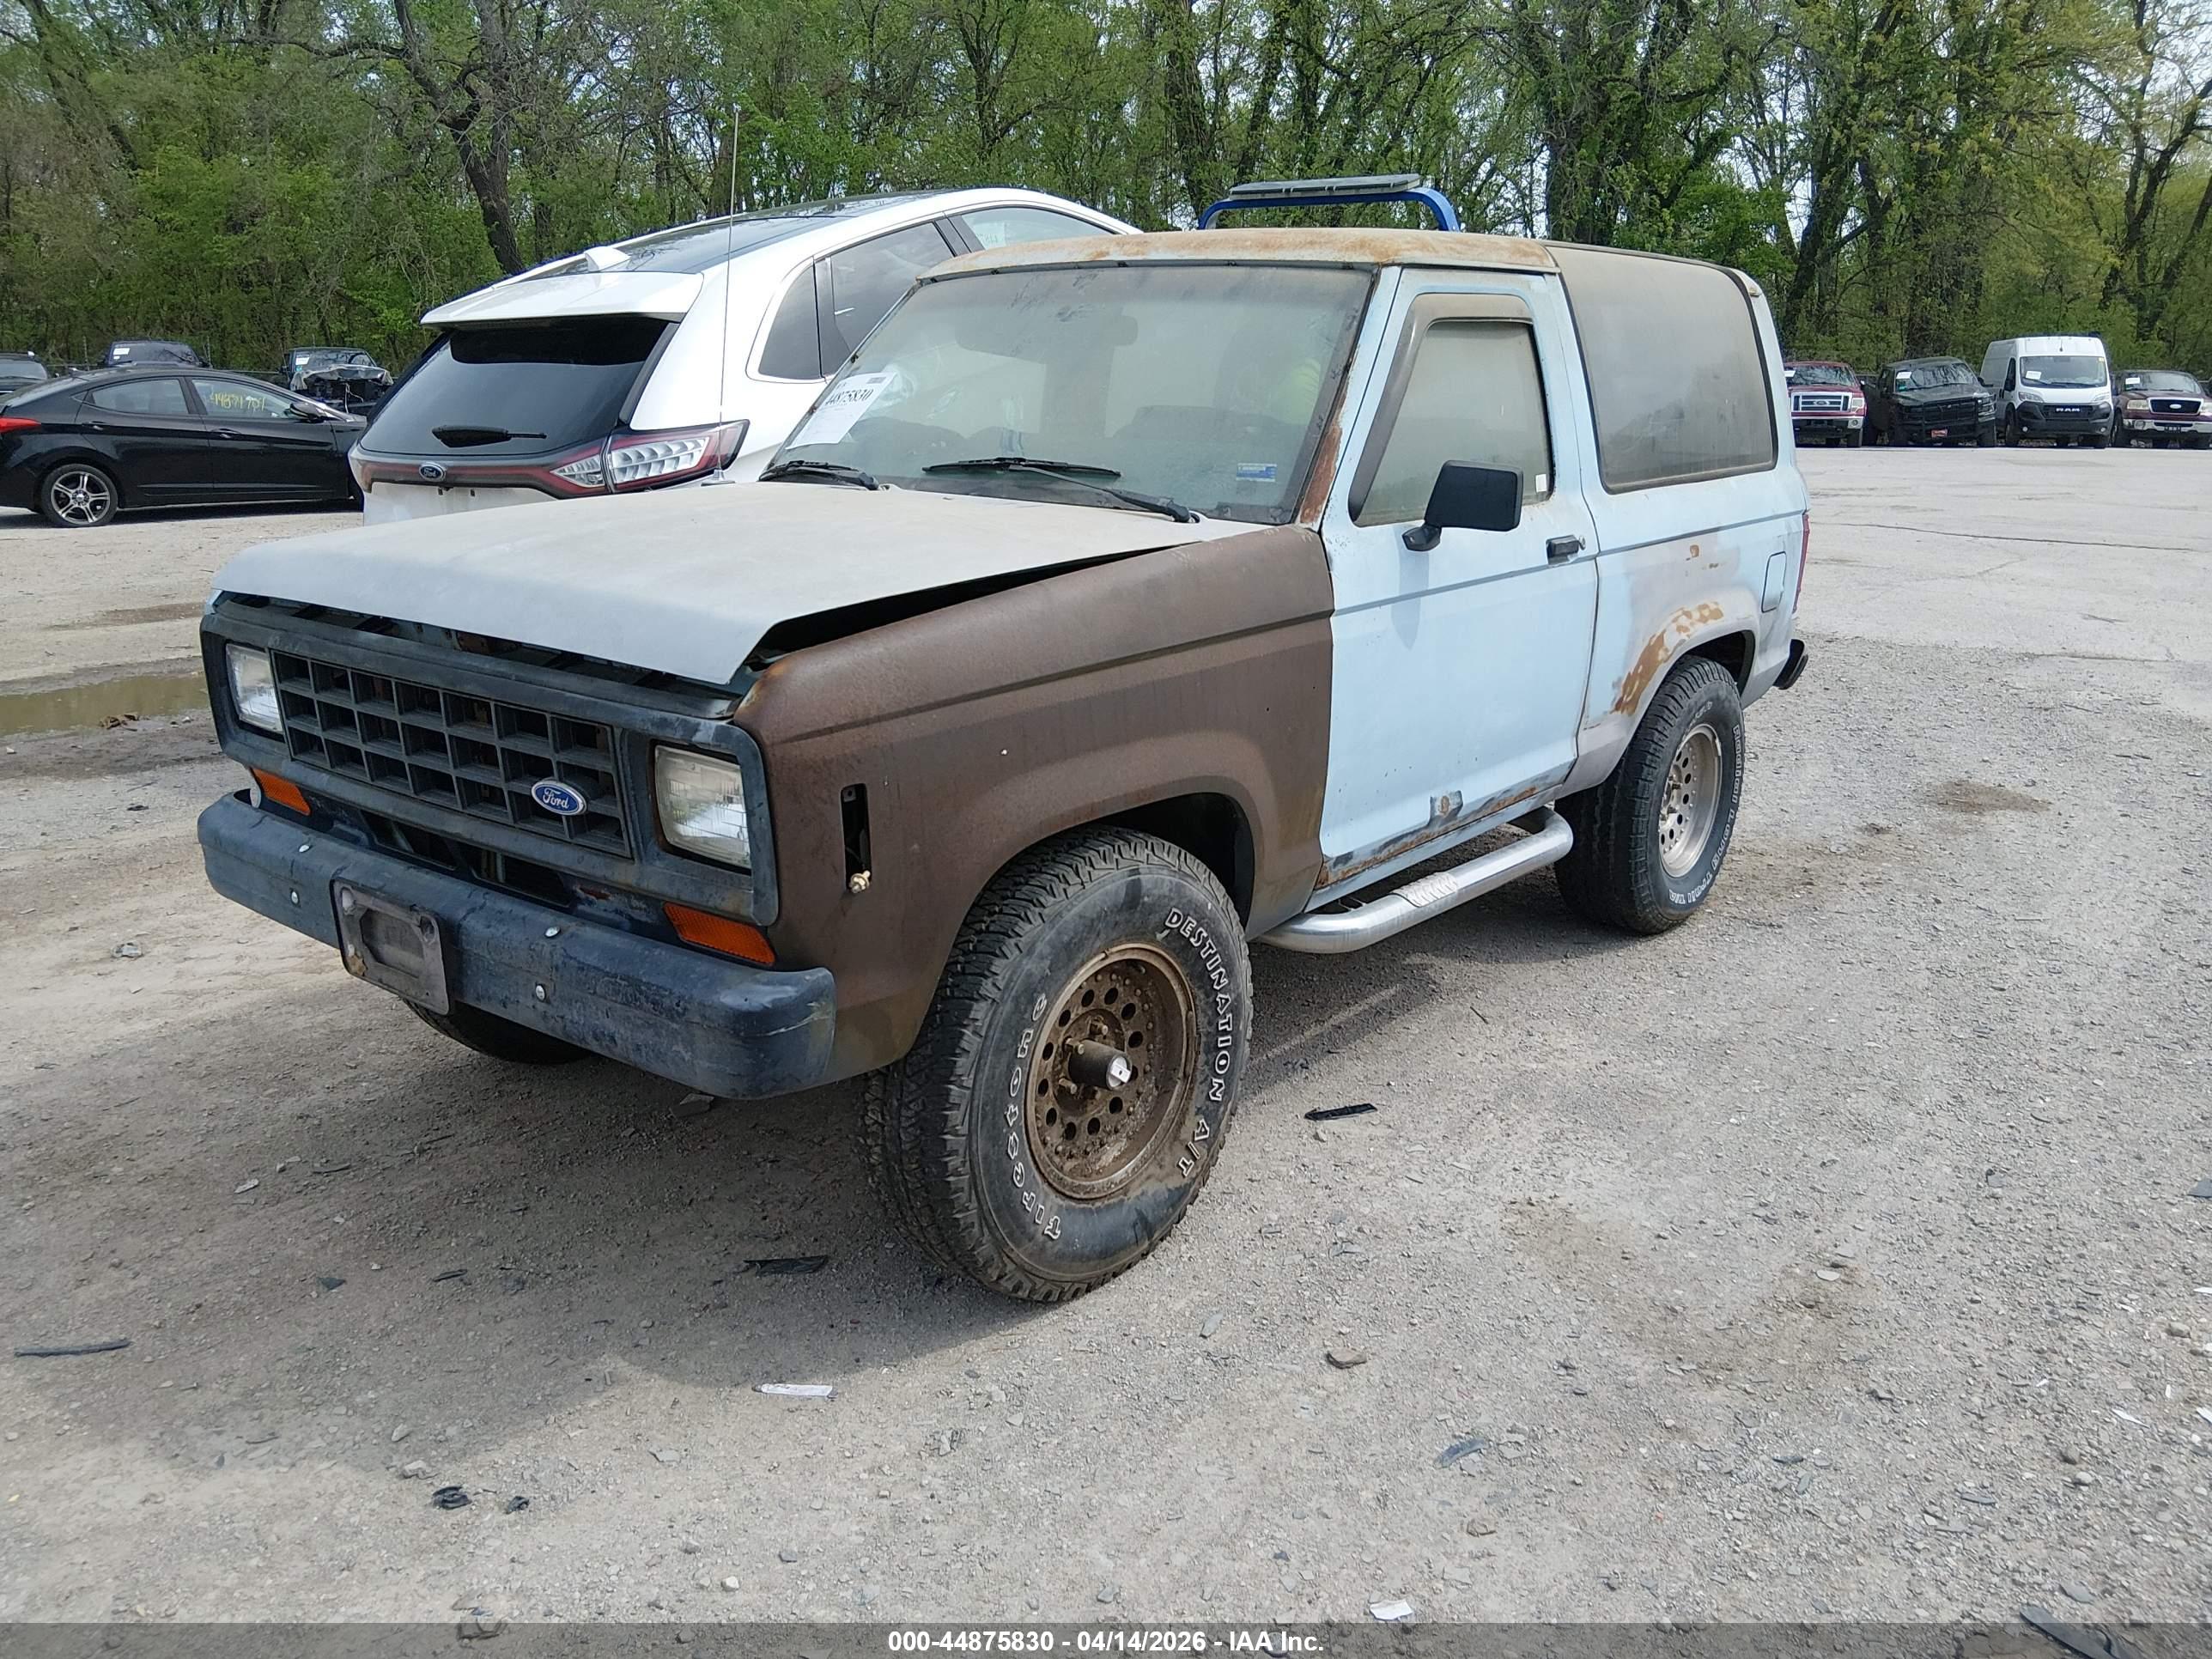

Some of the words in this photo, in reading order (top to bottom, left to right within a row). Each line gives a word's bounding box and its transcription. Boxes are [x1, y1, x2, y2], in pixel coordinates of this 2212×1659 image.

[542, 787, 570, 810] Ford
[1165, 907, 1236, 1103] DESTINATION
[1005, 992, 1061, 1242] Firestone
[1178, 1117, 1211, 1178] A/T
